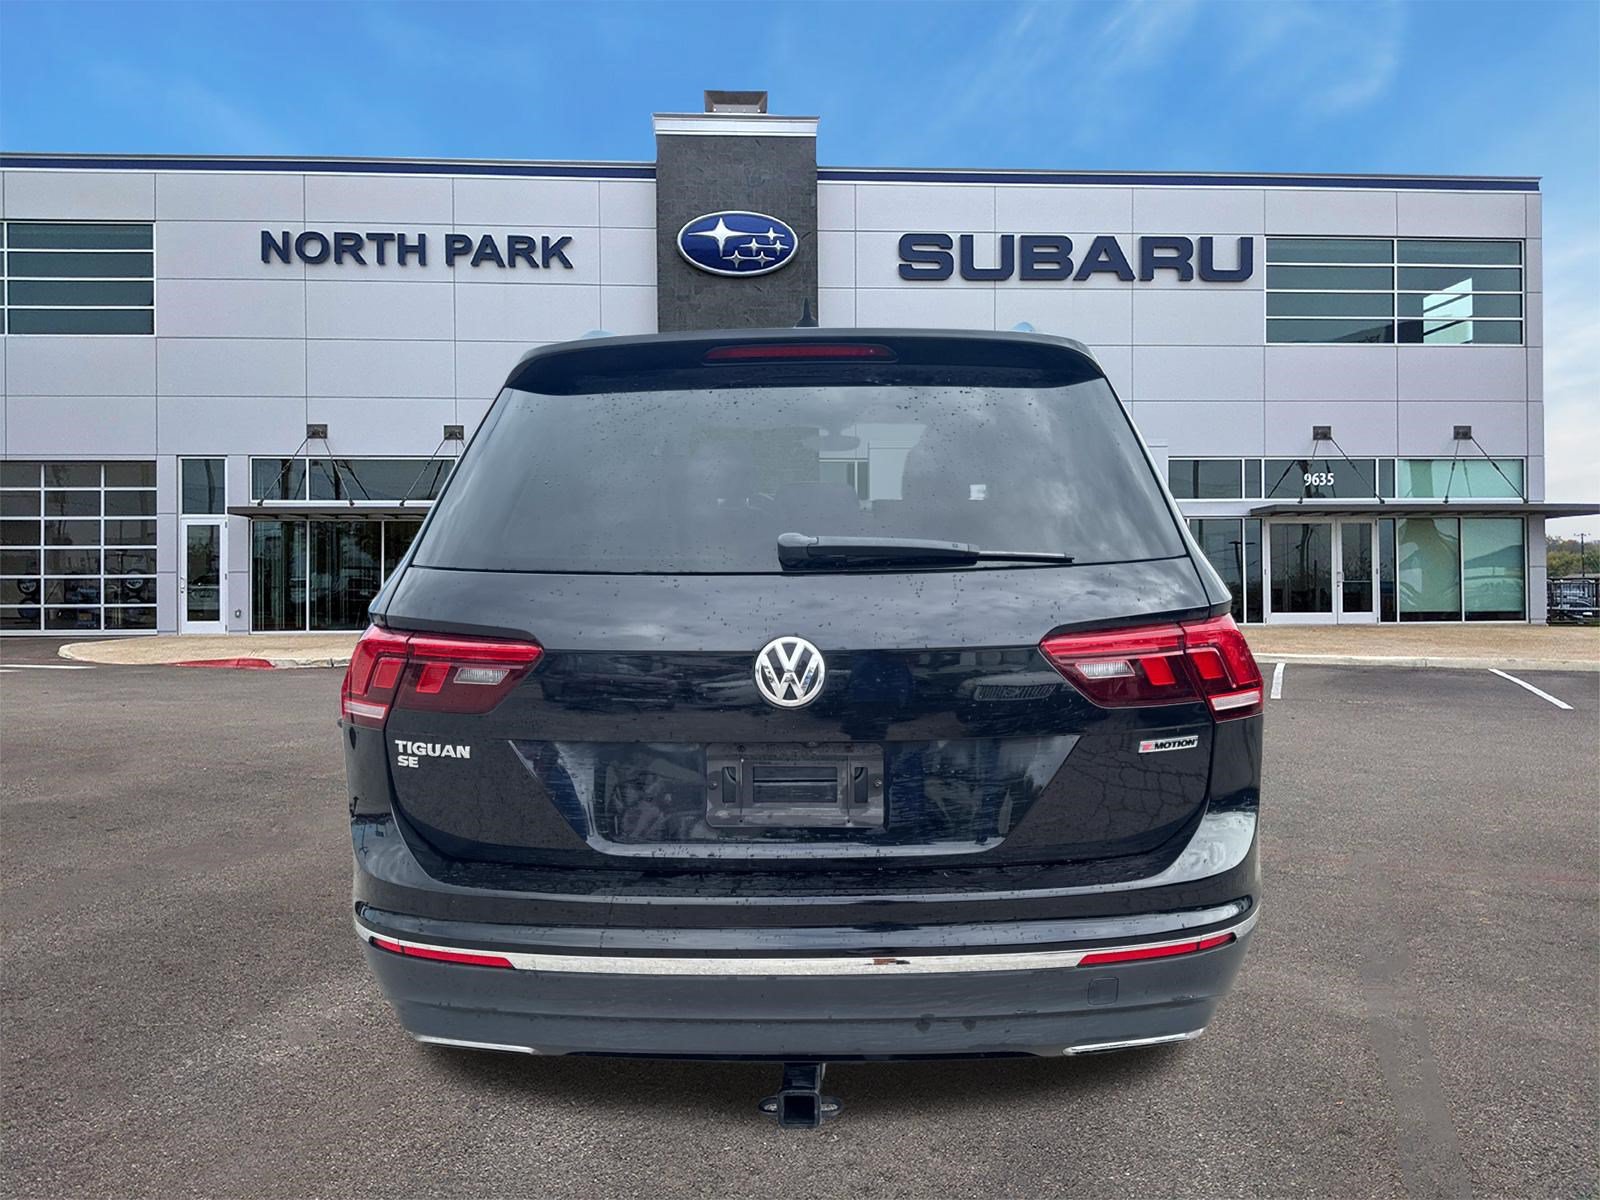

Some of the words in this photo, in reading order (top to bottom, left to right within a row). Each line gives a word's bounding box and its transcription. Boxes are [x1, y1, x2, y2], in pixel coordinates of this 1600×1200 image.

[260, 230, 427, 266] NORTH
[444, 233, 573, 269] PARK
[898, 233, 1254, 282] SUBARU
[1303, 472, 1335, 487] 9635
[394, 739, 471, 759] TIGUAN
[397, 755, 419, 768] SE
